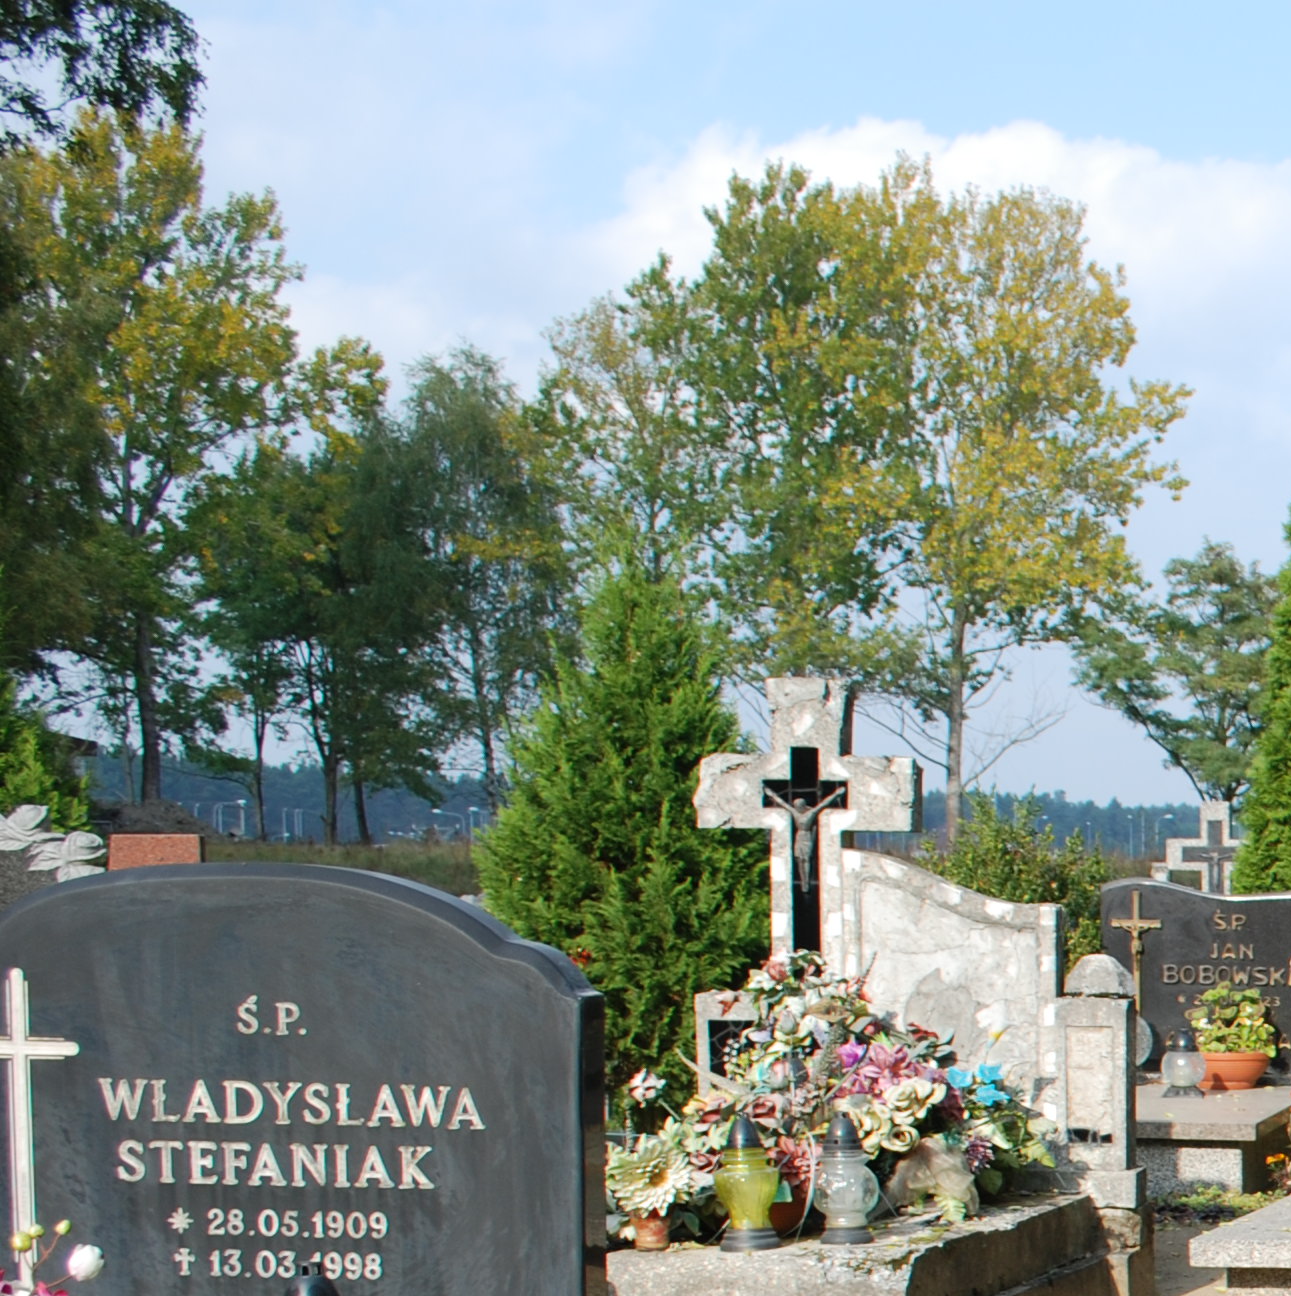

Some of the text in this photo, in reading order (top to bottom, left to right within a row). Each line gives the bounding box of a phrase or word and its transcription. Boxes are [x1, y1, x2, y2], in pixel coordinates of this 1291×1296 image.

[1209, 942, 1254, 960] JAN
[236, 995, 307, 1036] Ś.P.
[97, 1077, 486, 1131] WŁADYSŁAWA
[116, 1139, 435, 1190] STEFANIAK
[206, 1208, 389, 1239] 28.05.1909
[209, 1248, 383, 1280] 13.03998
